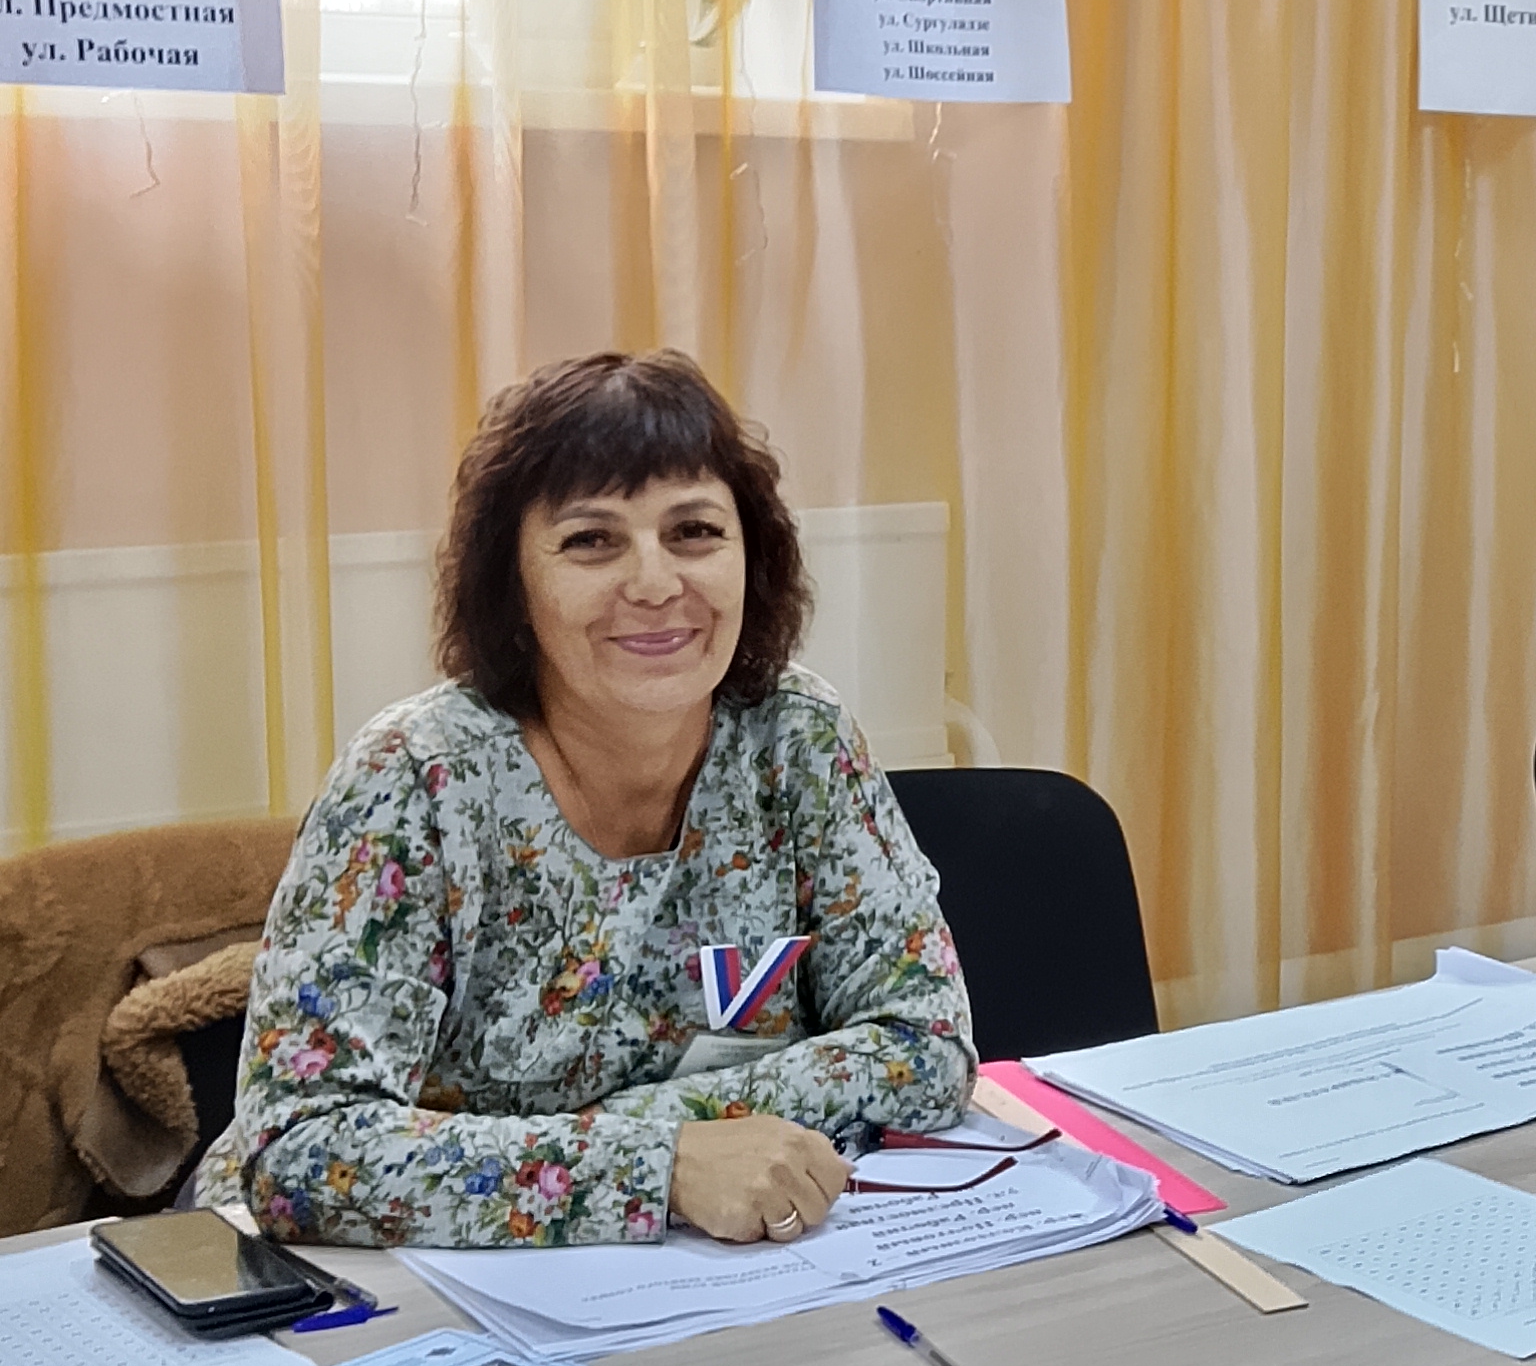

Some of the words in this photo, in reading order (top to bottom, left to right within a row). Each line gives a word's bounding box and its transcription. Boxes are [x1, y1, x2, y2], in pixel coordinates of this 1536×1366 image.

[878, 12, 899, 28] ул.
[1449, 6, 1478, 25] ул.
[21, 41, 66, 67] ул.
[76, 38, 199, 66] Рабочая
[883, 39, 904, 56] ул.
[908, 39, 990, 57] Школьная
[883, 66, 905, 82] ул.
[908, 66, 995, 84] Шоссейная
